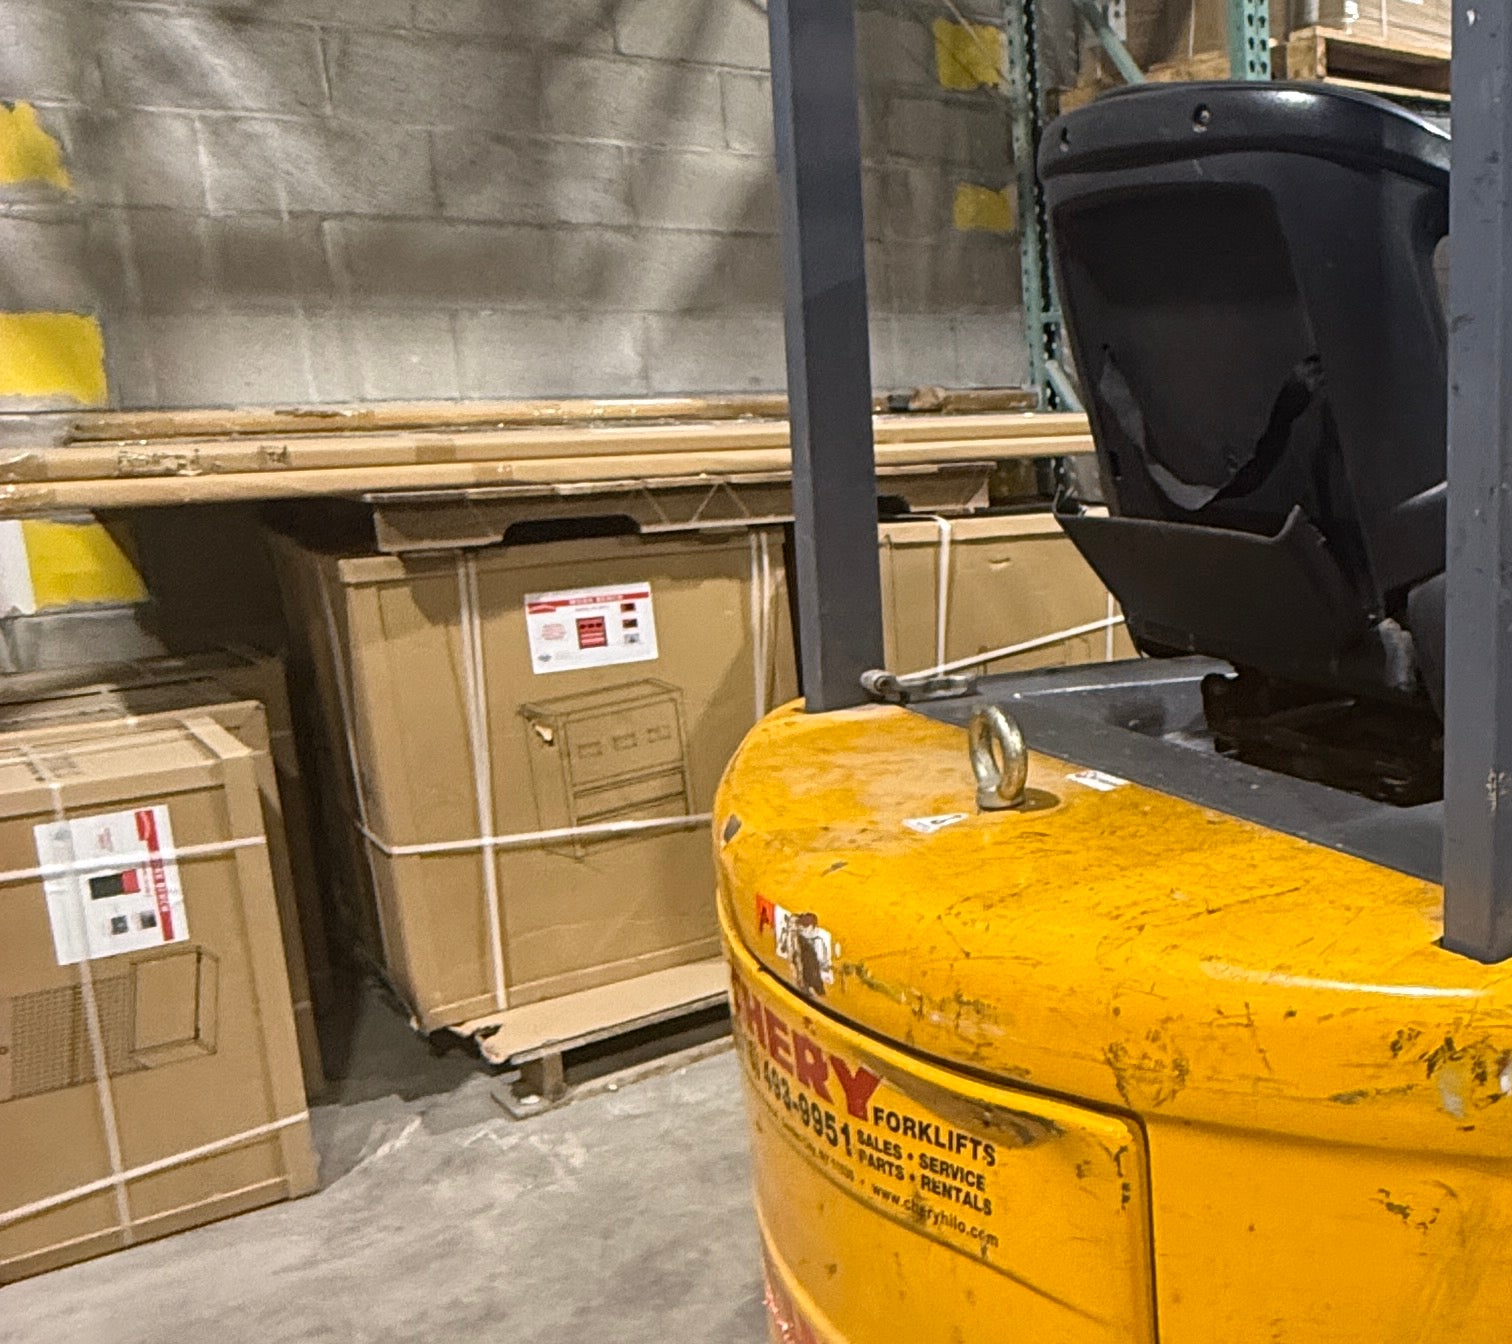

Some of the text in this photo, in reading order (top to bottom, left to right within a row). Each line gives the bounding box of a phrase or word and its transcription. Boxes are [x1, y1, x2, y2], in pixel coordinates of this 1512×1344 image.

[857, 1129, 986, 1193] SALES SERVICE
[873, 1105, 997, 1168] FORKLIFTS
[858, 1147, 992, 1217] PARTS RENTALS
